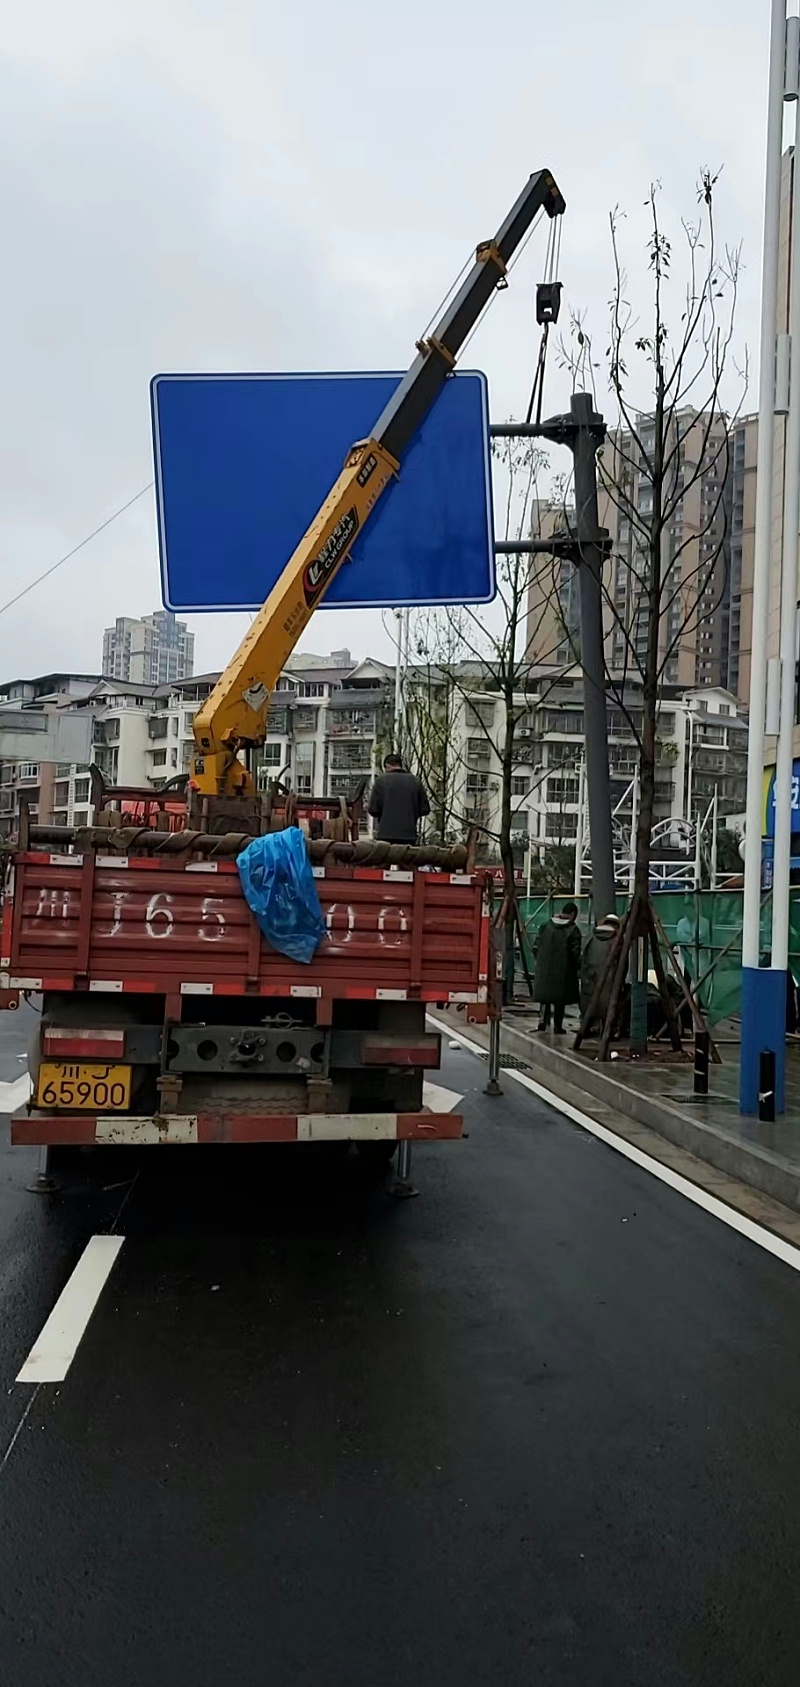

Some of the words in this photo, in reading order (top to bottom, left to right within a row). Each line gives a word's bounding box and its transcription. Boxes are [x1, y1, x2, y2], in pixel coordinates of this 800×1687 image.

[324, 550, 338, 569] CLW
[335, 520, 354, 551] GROUP
[42, 1080, 126, 1107] 65900
